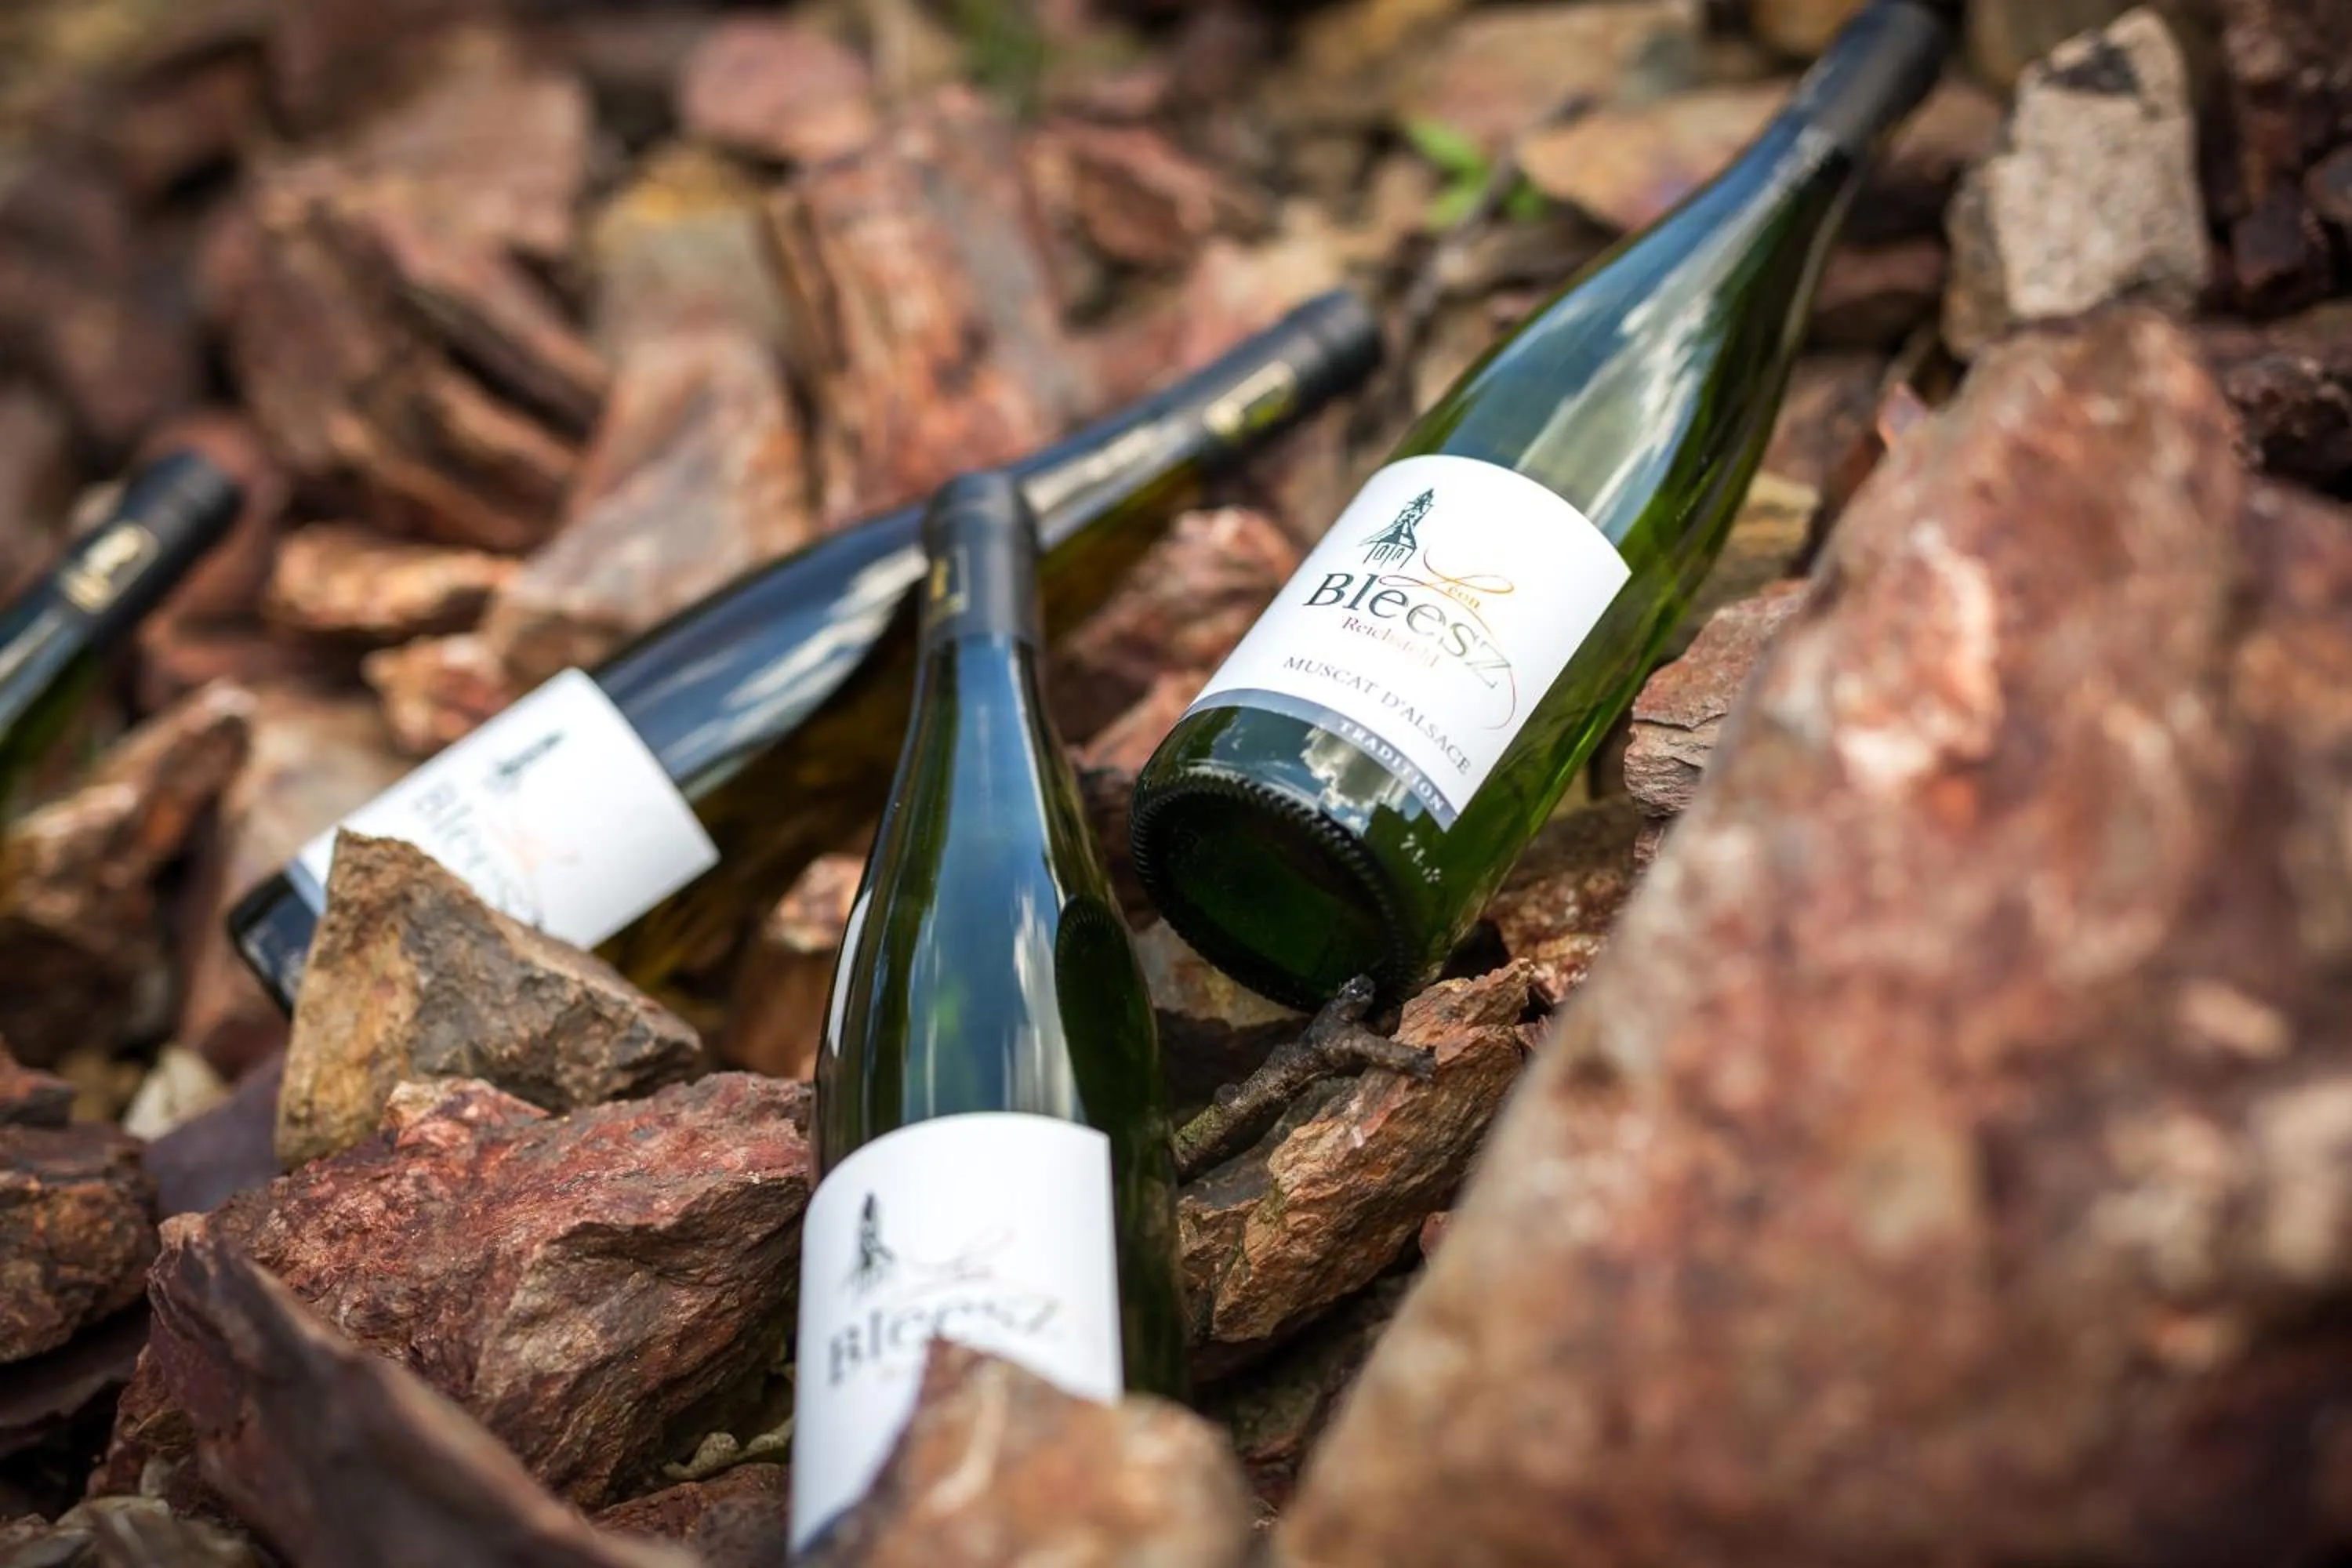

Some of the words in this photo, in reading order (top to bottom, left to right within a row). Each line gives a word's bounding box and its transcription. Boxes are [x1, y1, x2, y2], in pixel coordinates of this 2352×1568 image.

[1302, 573, 1512, 689] Bleesz
[1283, 655, 1380, 695] MUSCAT
[1380, 691, 1472, 776] D'ALSACE
[1338, 718, 1446, 812] TRADITION
